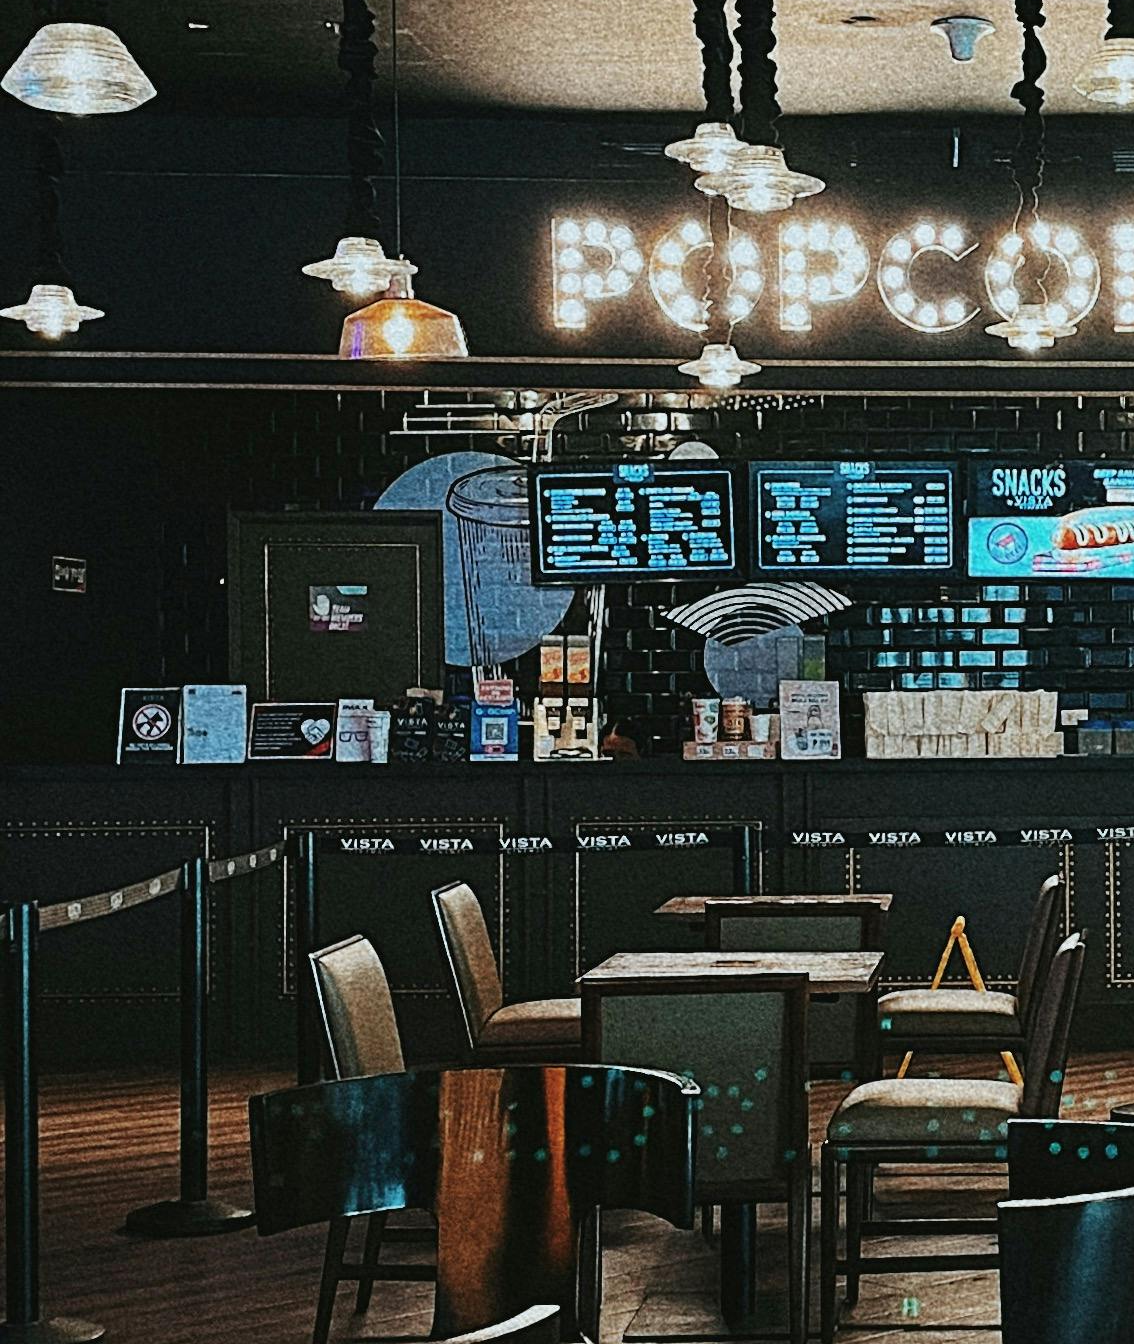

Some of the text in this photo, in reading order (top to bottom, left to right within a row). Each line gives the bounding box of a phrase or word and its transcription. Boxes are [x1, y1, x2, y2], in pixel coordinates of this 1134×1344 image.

[991, 468, 1067, 497] SNACKS
[498, 836, 553, 849] VISTA
[577, 834, 632, 848] VISTA
[655, 832, 710, 846] VISTA
[792, 832, 845, 844] VISTA
[868, 831, 921, 844] VISTA
[944, 830, 997, 843] VISTA
[1020, 829, 1073, 843] VISTA
[340, 837, 395, 850] VISTA
[419, 837, 474, 850] VISTA
